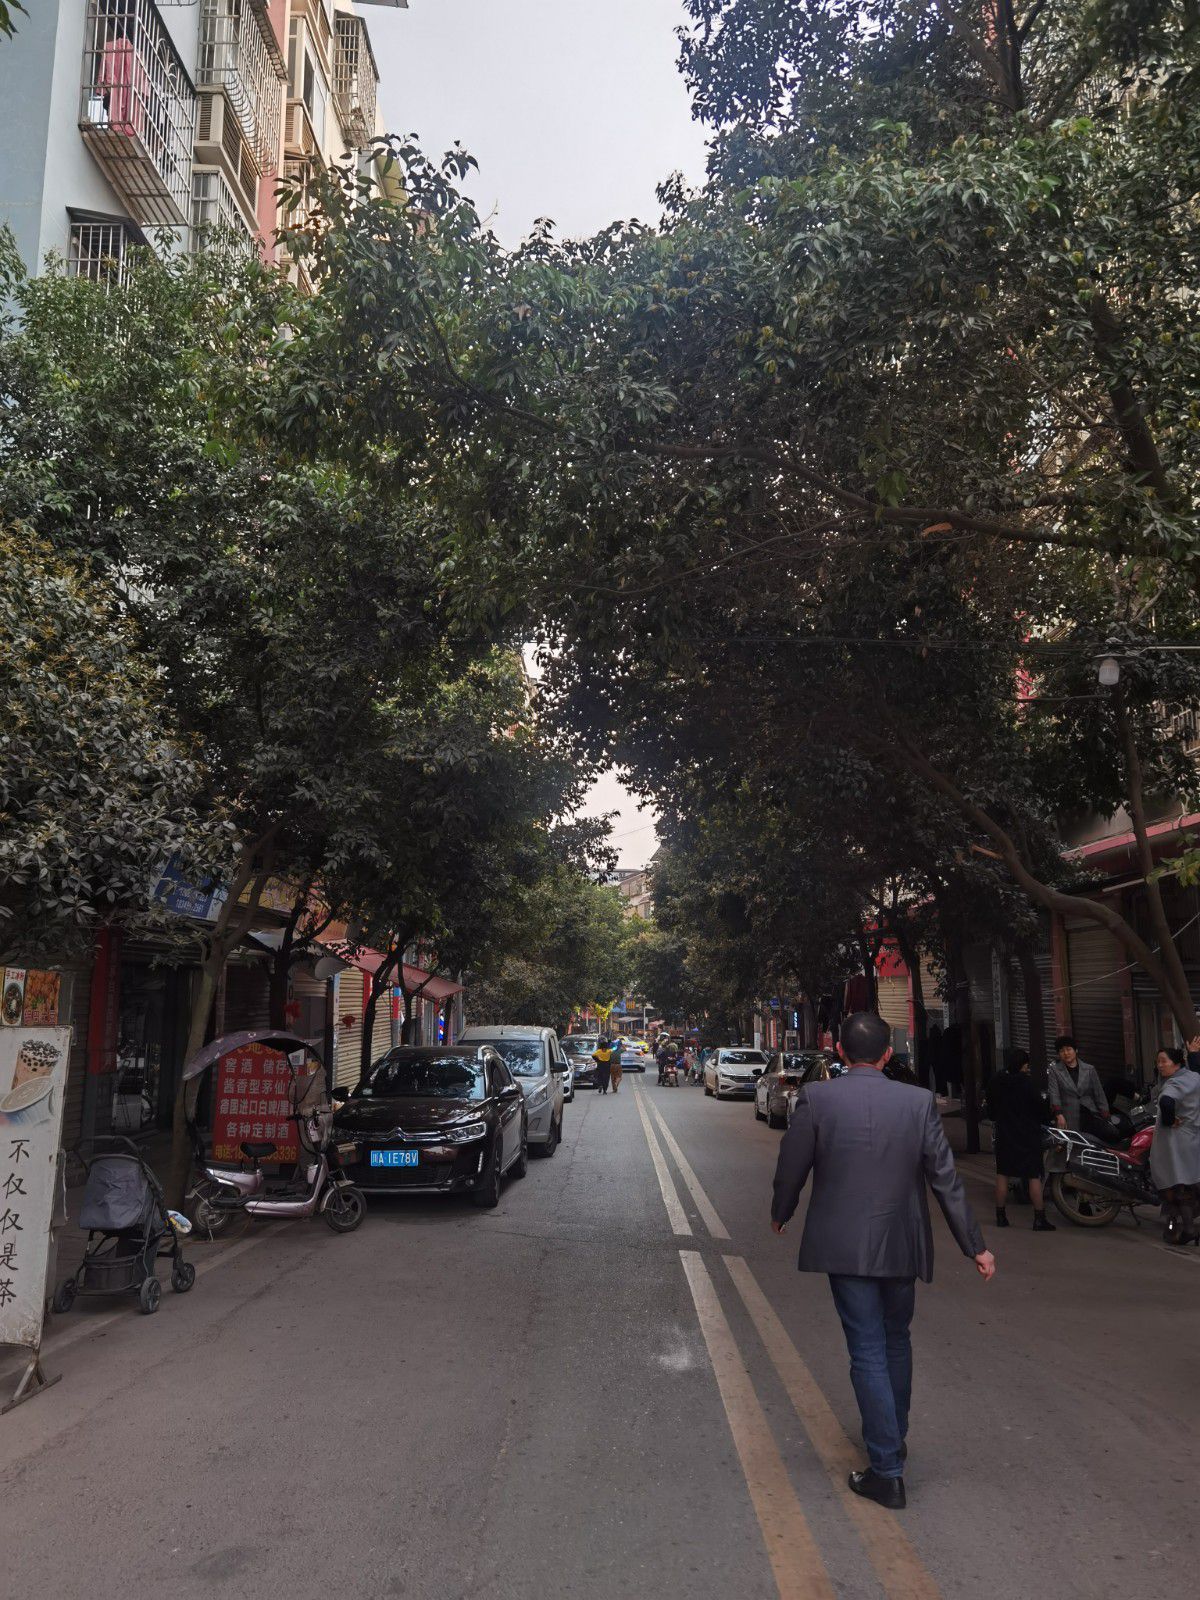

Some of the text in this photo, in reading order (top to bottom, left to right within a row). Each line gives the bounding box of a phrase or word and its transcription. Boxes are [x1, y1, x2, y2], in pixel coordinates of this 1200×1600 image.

[226, 1122, 289, 1138] 各种定制酒
[0, 1139, 31, 1307] 不仅仅是茶
